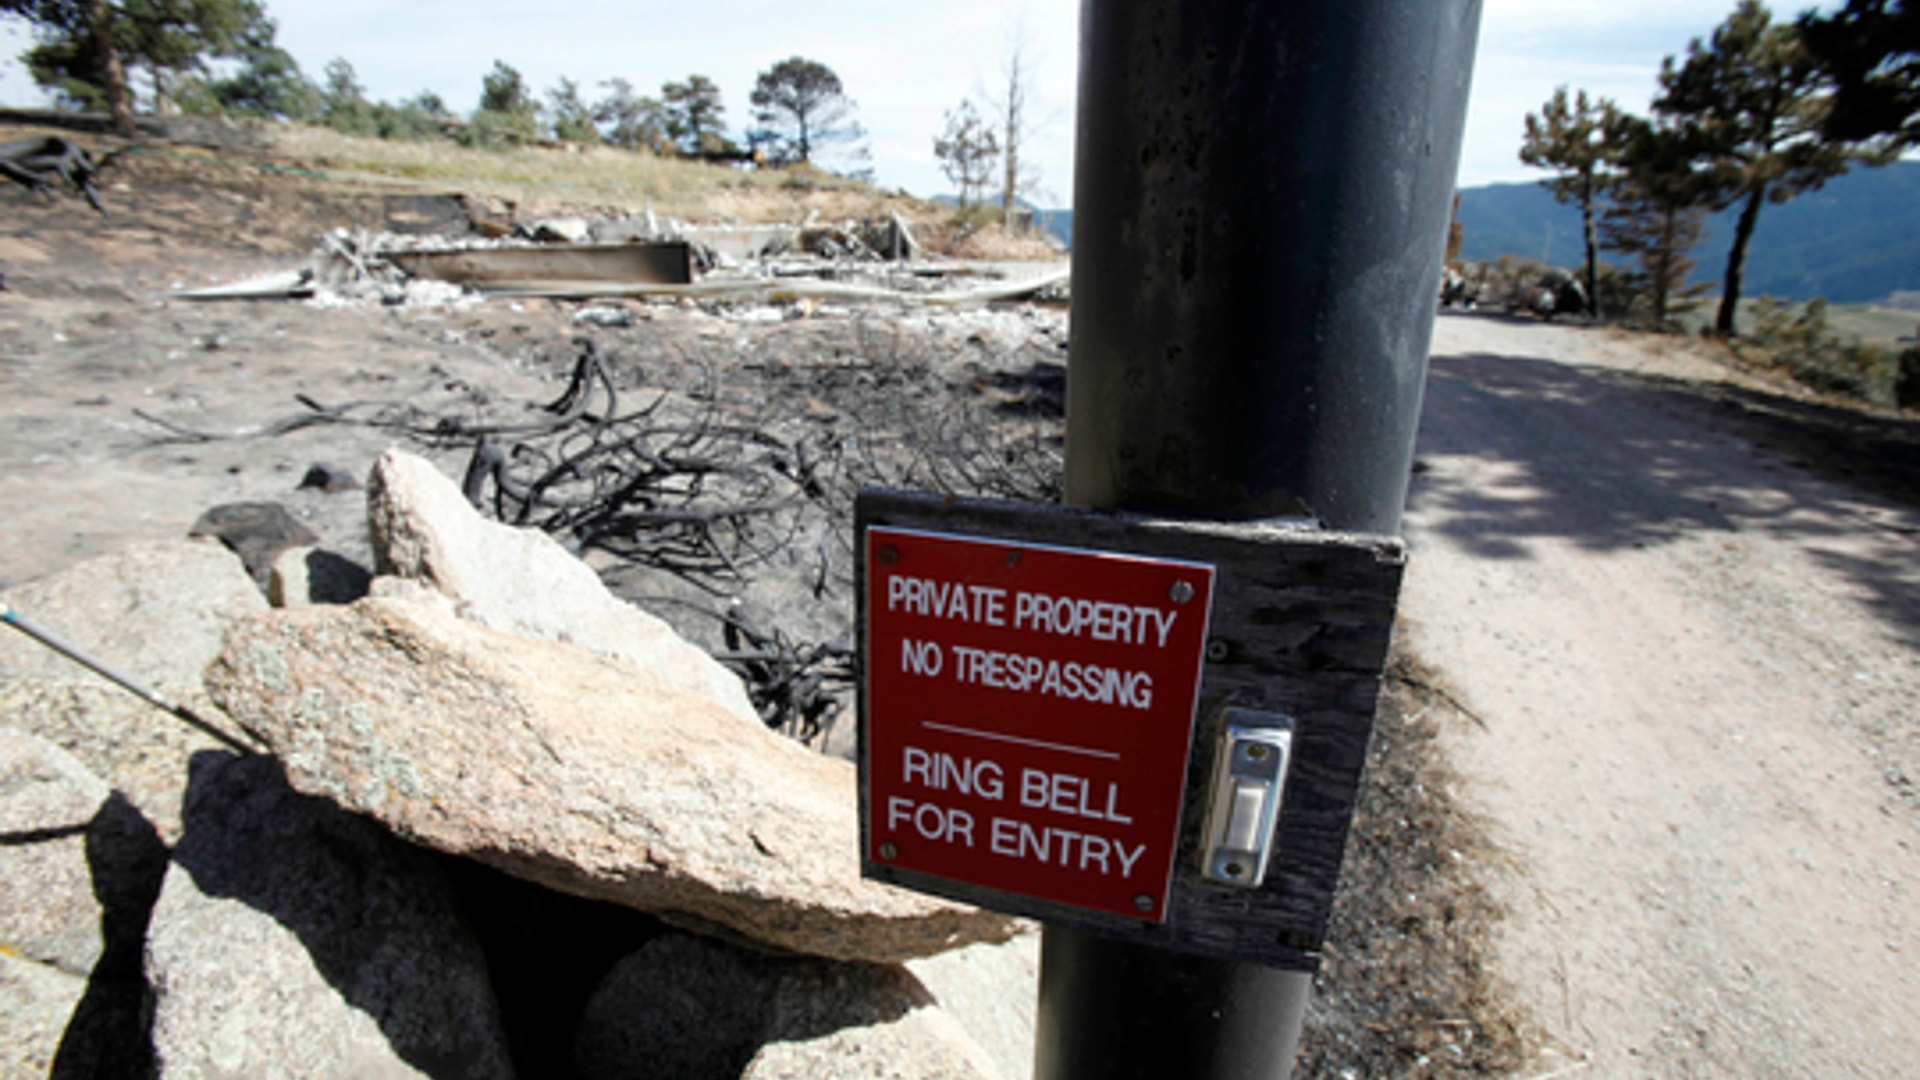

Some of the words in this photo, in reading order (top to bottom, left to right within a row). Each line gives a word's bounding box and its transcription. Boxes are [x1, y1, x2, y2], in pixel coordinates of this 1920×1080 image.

[886, 574, 1007, 627] PRIVATE
[1014, 592, 1177, 648] PROPERTY
[902, 638, 942, 677] NO
[953, 645, 1153, 710] TRESPASSING
[903, 747, 1004, 801] RING
[1020, 768, 1132, 824] BELL
[888, 796, 974, 847] FOR
[990, 817, 1146, 879] ENTRY
